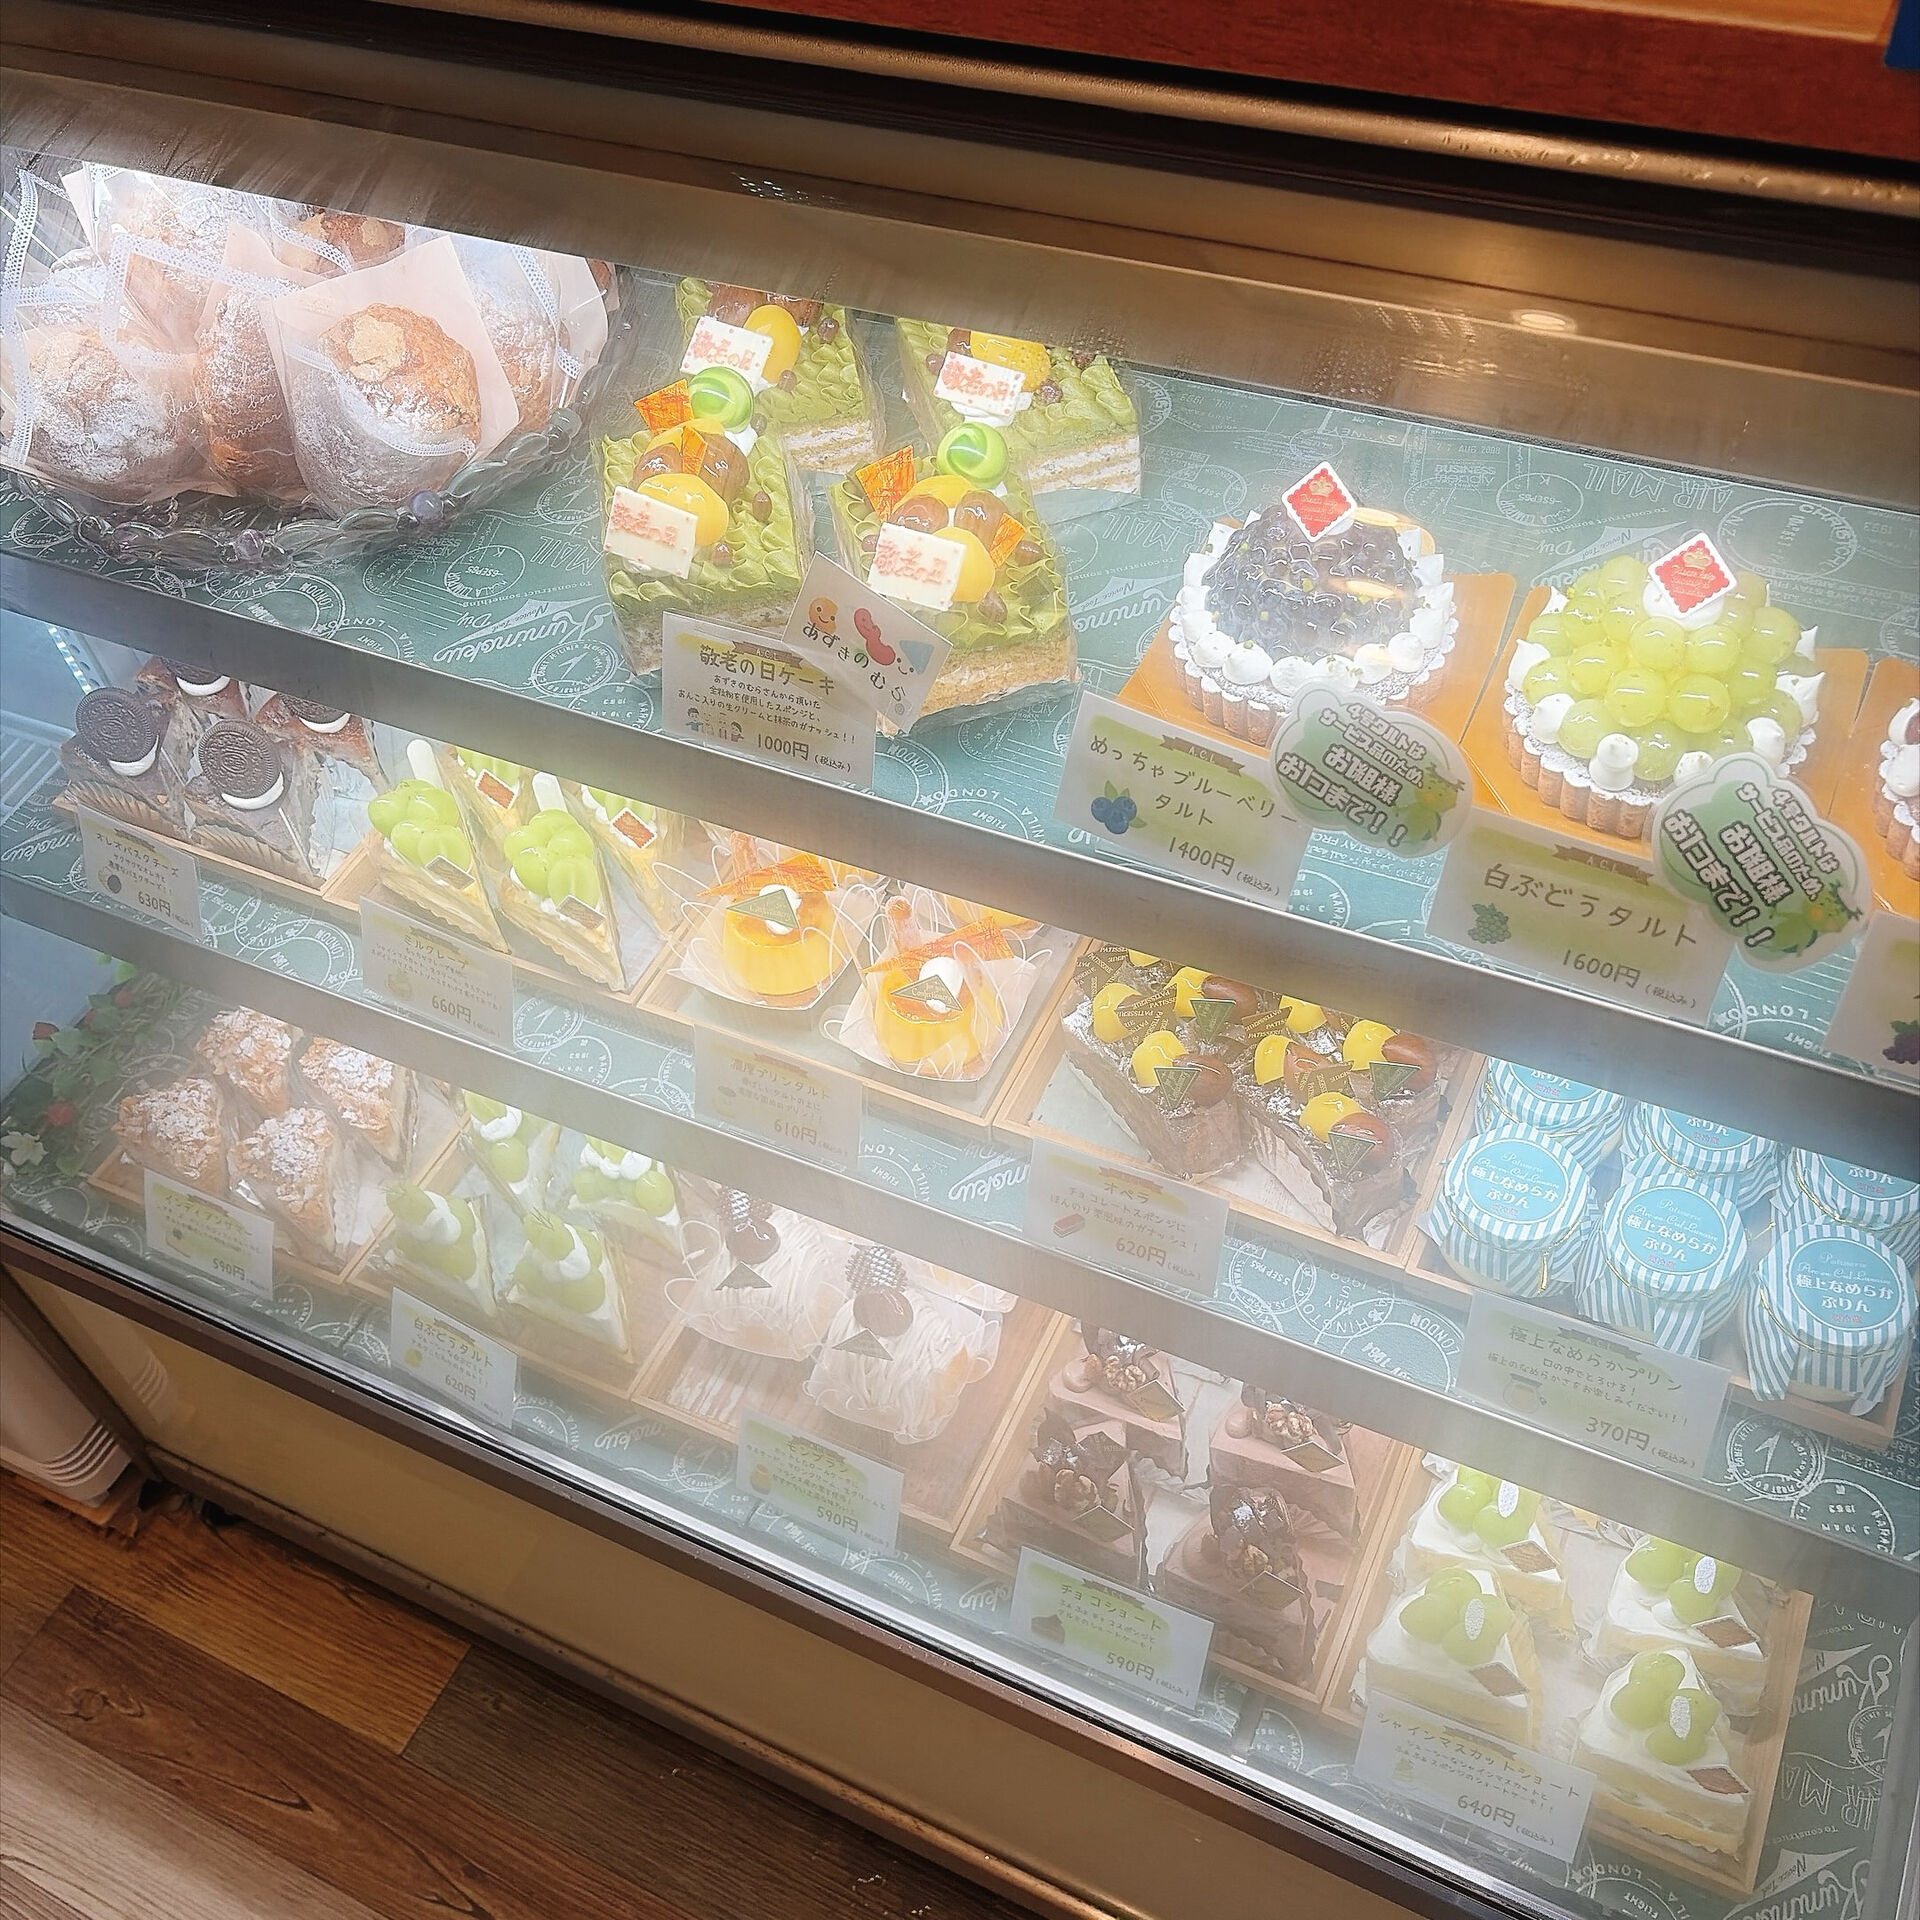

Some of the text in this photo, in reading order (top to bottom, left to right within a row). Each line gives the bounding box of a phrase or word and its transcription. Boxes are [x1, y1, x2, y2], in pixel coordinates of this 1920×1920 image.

[700, 643, 835, 697] 敬老の日ケーキ
[802, 621, 906, 704] あずきのむら
[713, 674, 821, 710] あずきのむらさんから頂いた
[1346, 702, 1427, 760] 4号タルトは
[757, 732, 852, 773] 1000円 (税込み)
[1090, 736, 1297, 823] めっちゃブルーベリー
[1154, 792, 1213, 827] タルト
[1770, 787, 1840, 874] 4号タルトは
[1168, 838, 1279, 896] 1400円 (税込み)
[138, 892, 171, 917] 630円
[1482, 864, 1697, 948] 白ぶどうタルト
[404, 935, 470, 968] ミルクレープ
[1562, 948, 1695, 1009] 1600円 (税込み)
[432, 996, 471, 1024] 660円
[774, 1119, 817, 1145] 610円
[1104, 1182, 1150, 1204] オペラ
[1470, 1165, 1558, 1202] 極上なめらか
[1116, 1237, 1167, 1267] 620円
[1625, 1214, 1717, 1256] 極上なめらか
[213, 1258, 246, 1281] 590円
[1795, 1274, 1894, 1300] 極上なめらか
[415, 1317, 493, 1367] 白ぶどうタルト
[1509, 1325, 1682, 1391] 極上なめらかプリン
[445, 1375, 476, 1401] 620円
[1543, 1358, 1636, 1396] 口の中でとろける!
[785, 1439, 848, 1472] モンブラン
[1586, 1416, 1696, 1468] 370円 (税込み)
[817, 1506, 858, 1533] 590円
[1062, 1584, 1161, 1631] チョコショート
[1107, 1652, 1154, 1680] 590円
[1376, 1713, 1580, 1799] シャインマスカットショート
[1458, 1795, 1516, 1828] 640円
